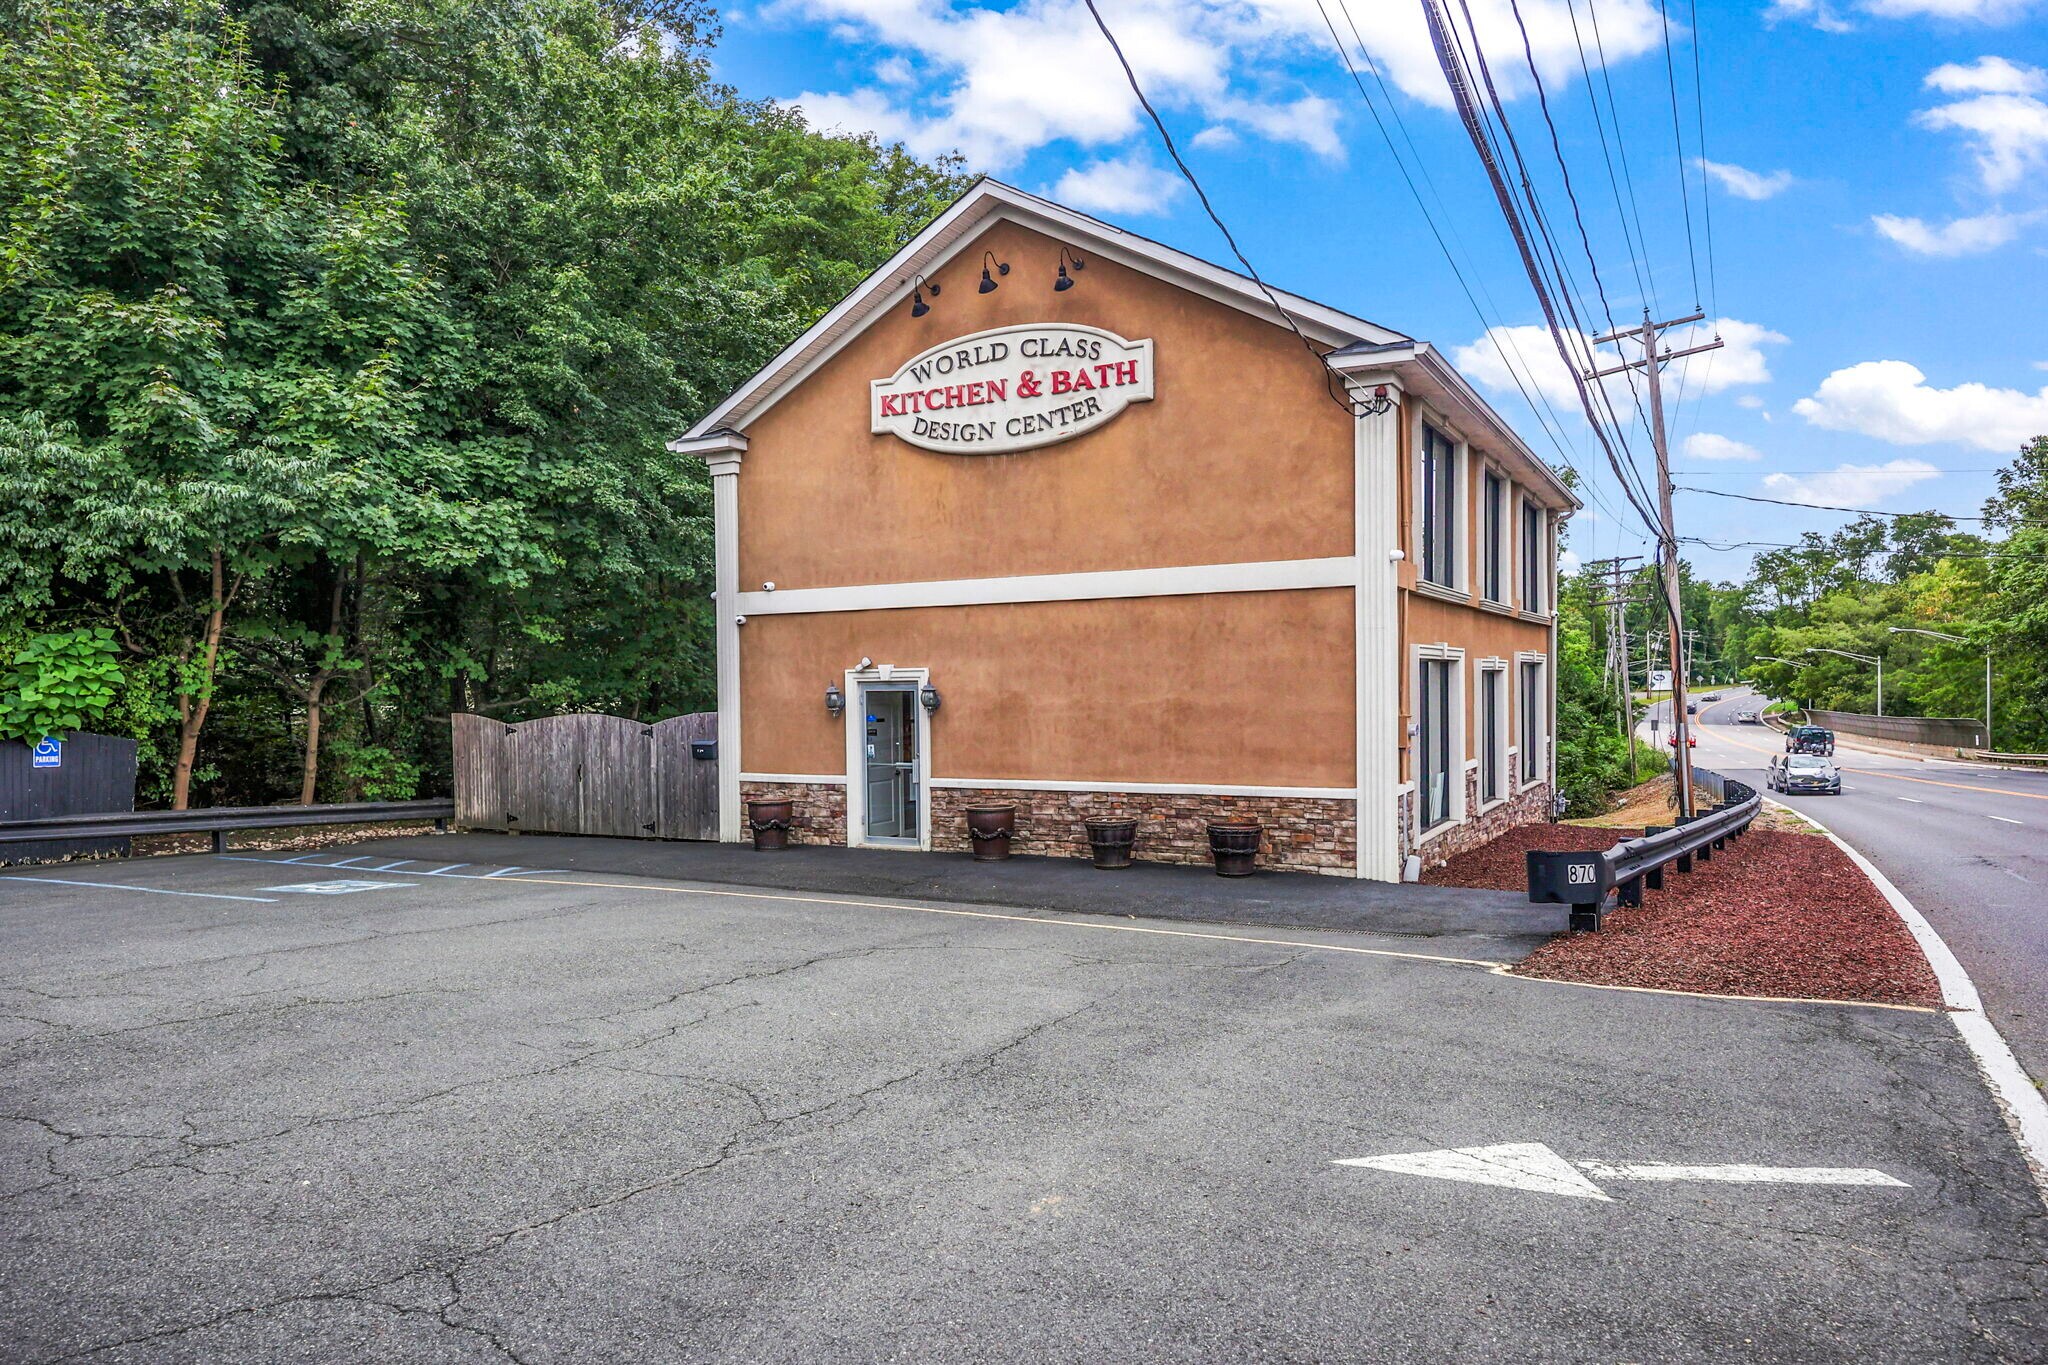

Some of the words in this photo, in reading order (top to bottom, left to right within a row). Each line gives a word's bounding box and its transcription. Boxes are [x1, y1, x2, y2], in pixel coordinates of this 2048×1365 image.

[910, 342, 1009, 383] WORLD
[1020, 338, 1102, 360] CLASS
[880, 378, 1008, 417] KITCHEN
[1016, 370, 1042, 398] &
[1051, 360, 1138, 395] BATH
[912, 416, 996, 441] DESIGN
[1006, 396, 1102, 436] CENTER
[1569, 865, 1595, 883] 870
